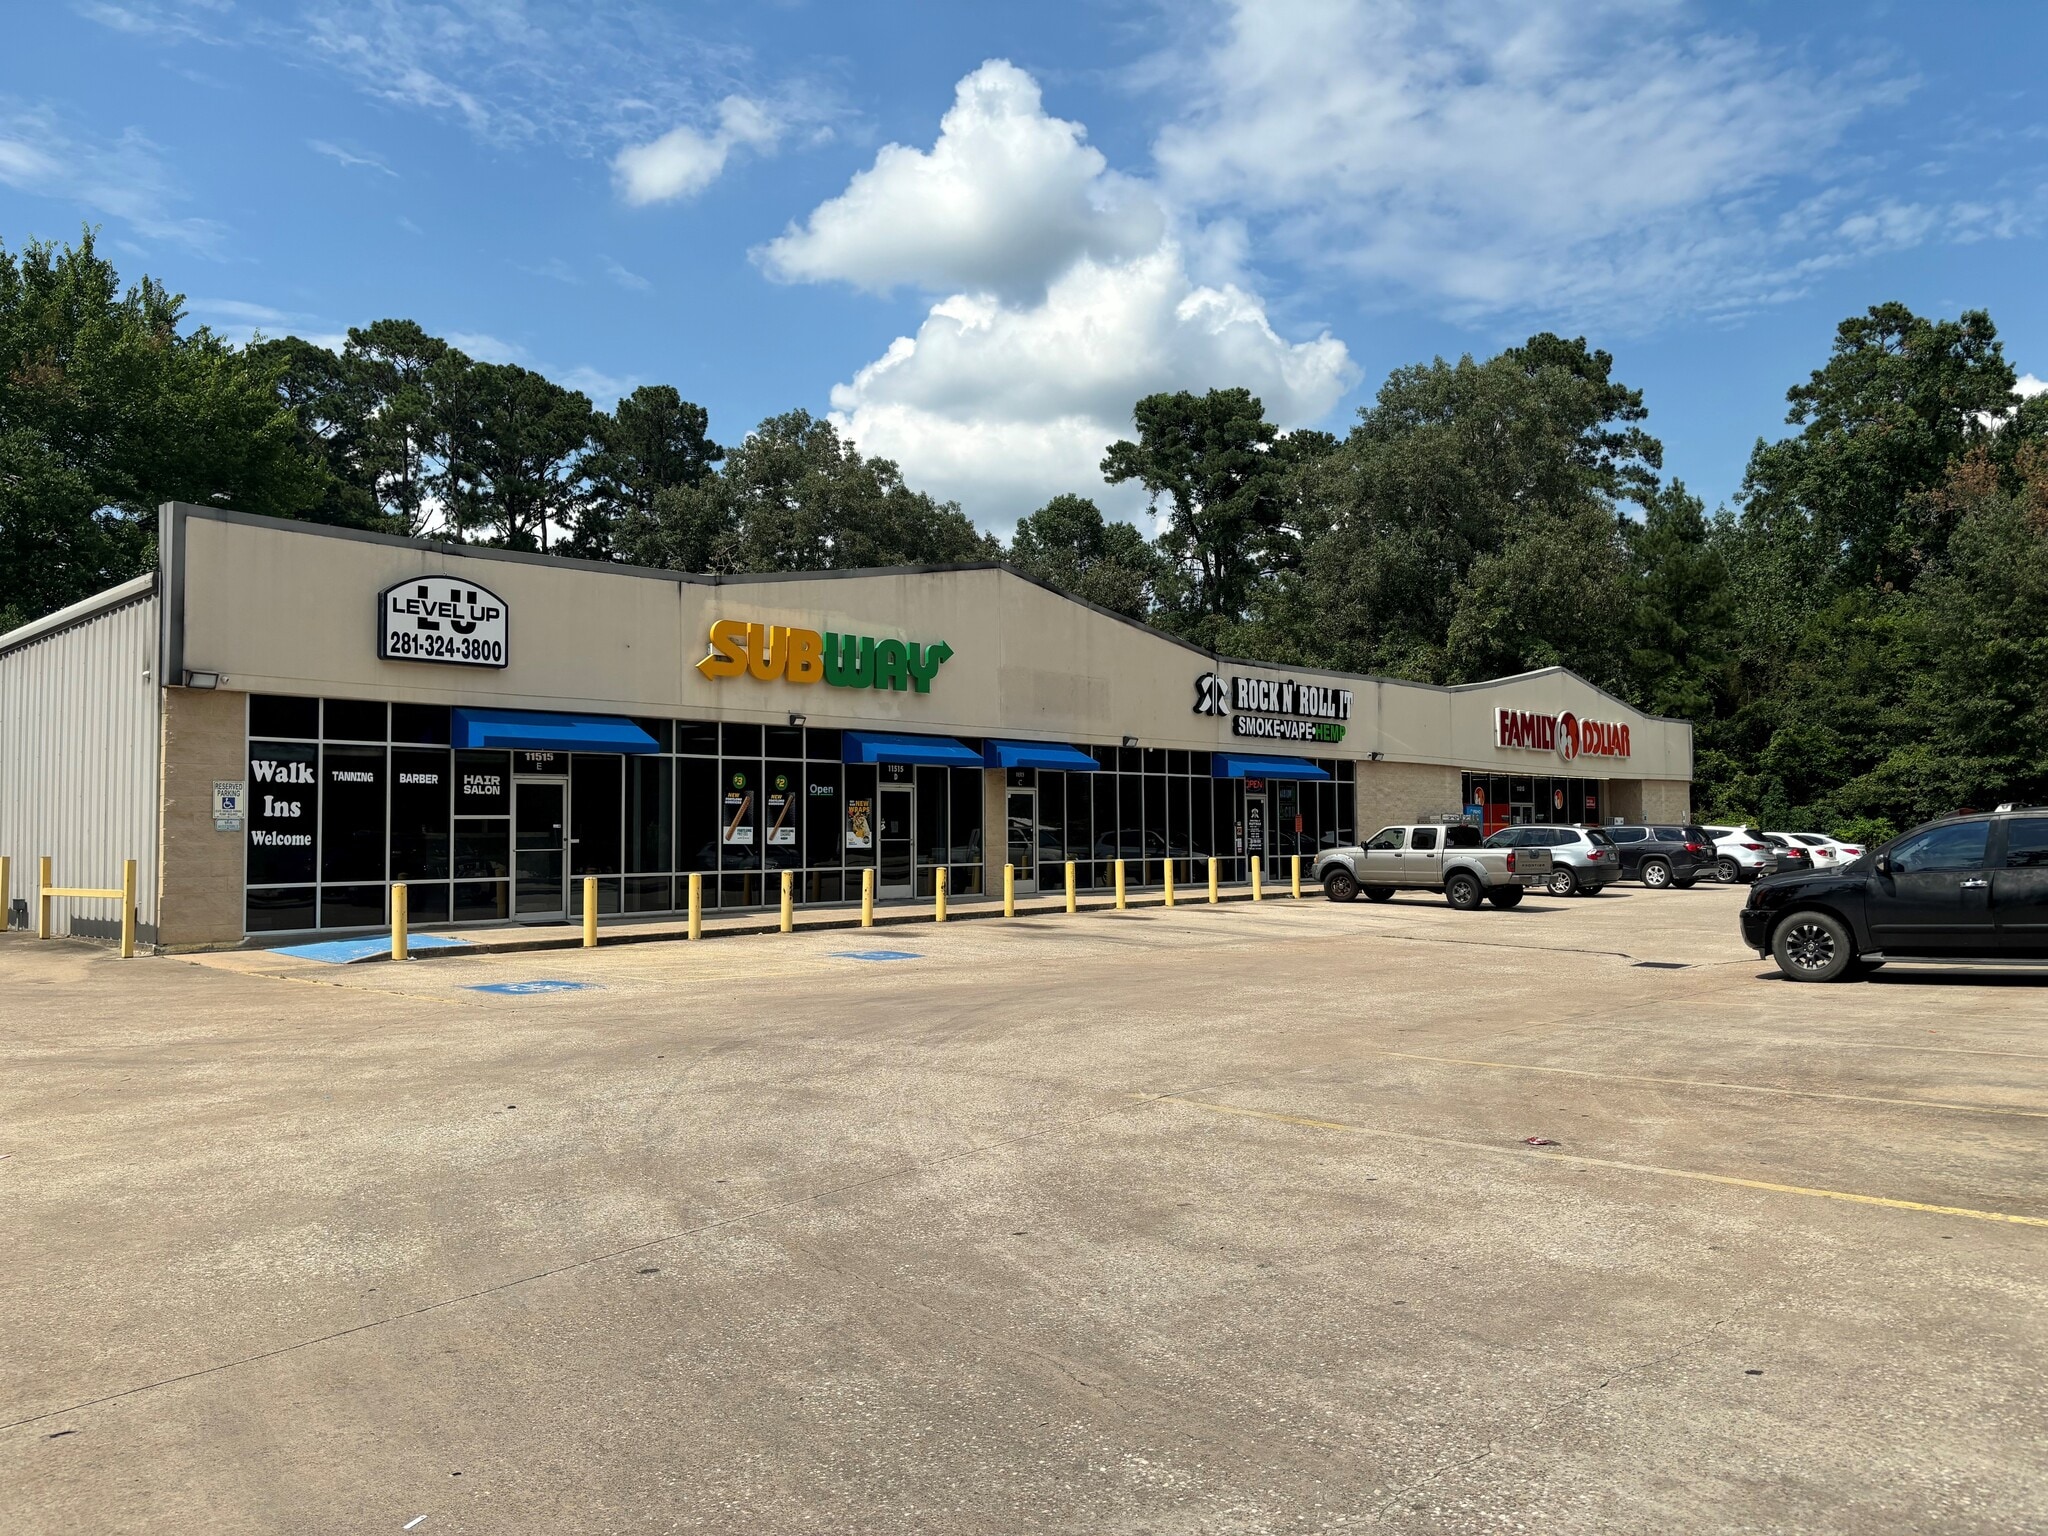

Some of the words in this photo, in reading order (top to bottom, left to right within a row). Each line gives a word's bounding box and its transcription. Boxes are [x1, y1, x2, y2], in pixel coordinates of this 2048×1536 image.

[393, 597, 465, 620] LEVEL
[471, 605, 500, 622] UP
[391, 631, 503, 662] 281-324-3800
[696, 619, 954, 694] SUBWAY
[1238, 678, 1280, 712] ROCK
[1300, 685, 1337, 718] ROLL
[1339, 690, 1354, 719] IT
[1239, 716, 1281, 738] SMOKE
[1283, 720, 1313, 740] VAPE
[1315, 723, 1346, 742] HEMP
[1498, 709, 1559, 751] FAMILY
[1581, 718, 1631, 758] DOLLAR
[524, 752, 554, 761] 11515
[251, 760, 316, 783] Walk
[536, 762, 543, 770] E
[888, 764, 905, 773] 11515
[332, 771, 373, 783] TANNING
[399, 773, 438, 784] BARBER
[464, 775, 500, 785] HAIR
[734, 776, 743, 786] $3
[776, 778, 786, 788] $2
[463, 785, 500, 795] SALON
[809, 784, 834, 796] Open
[264, 795, 302, 817] Ins
[251, 831, 312, 846] Welcome
